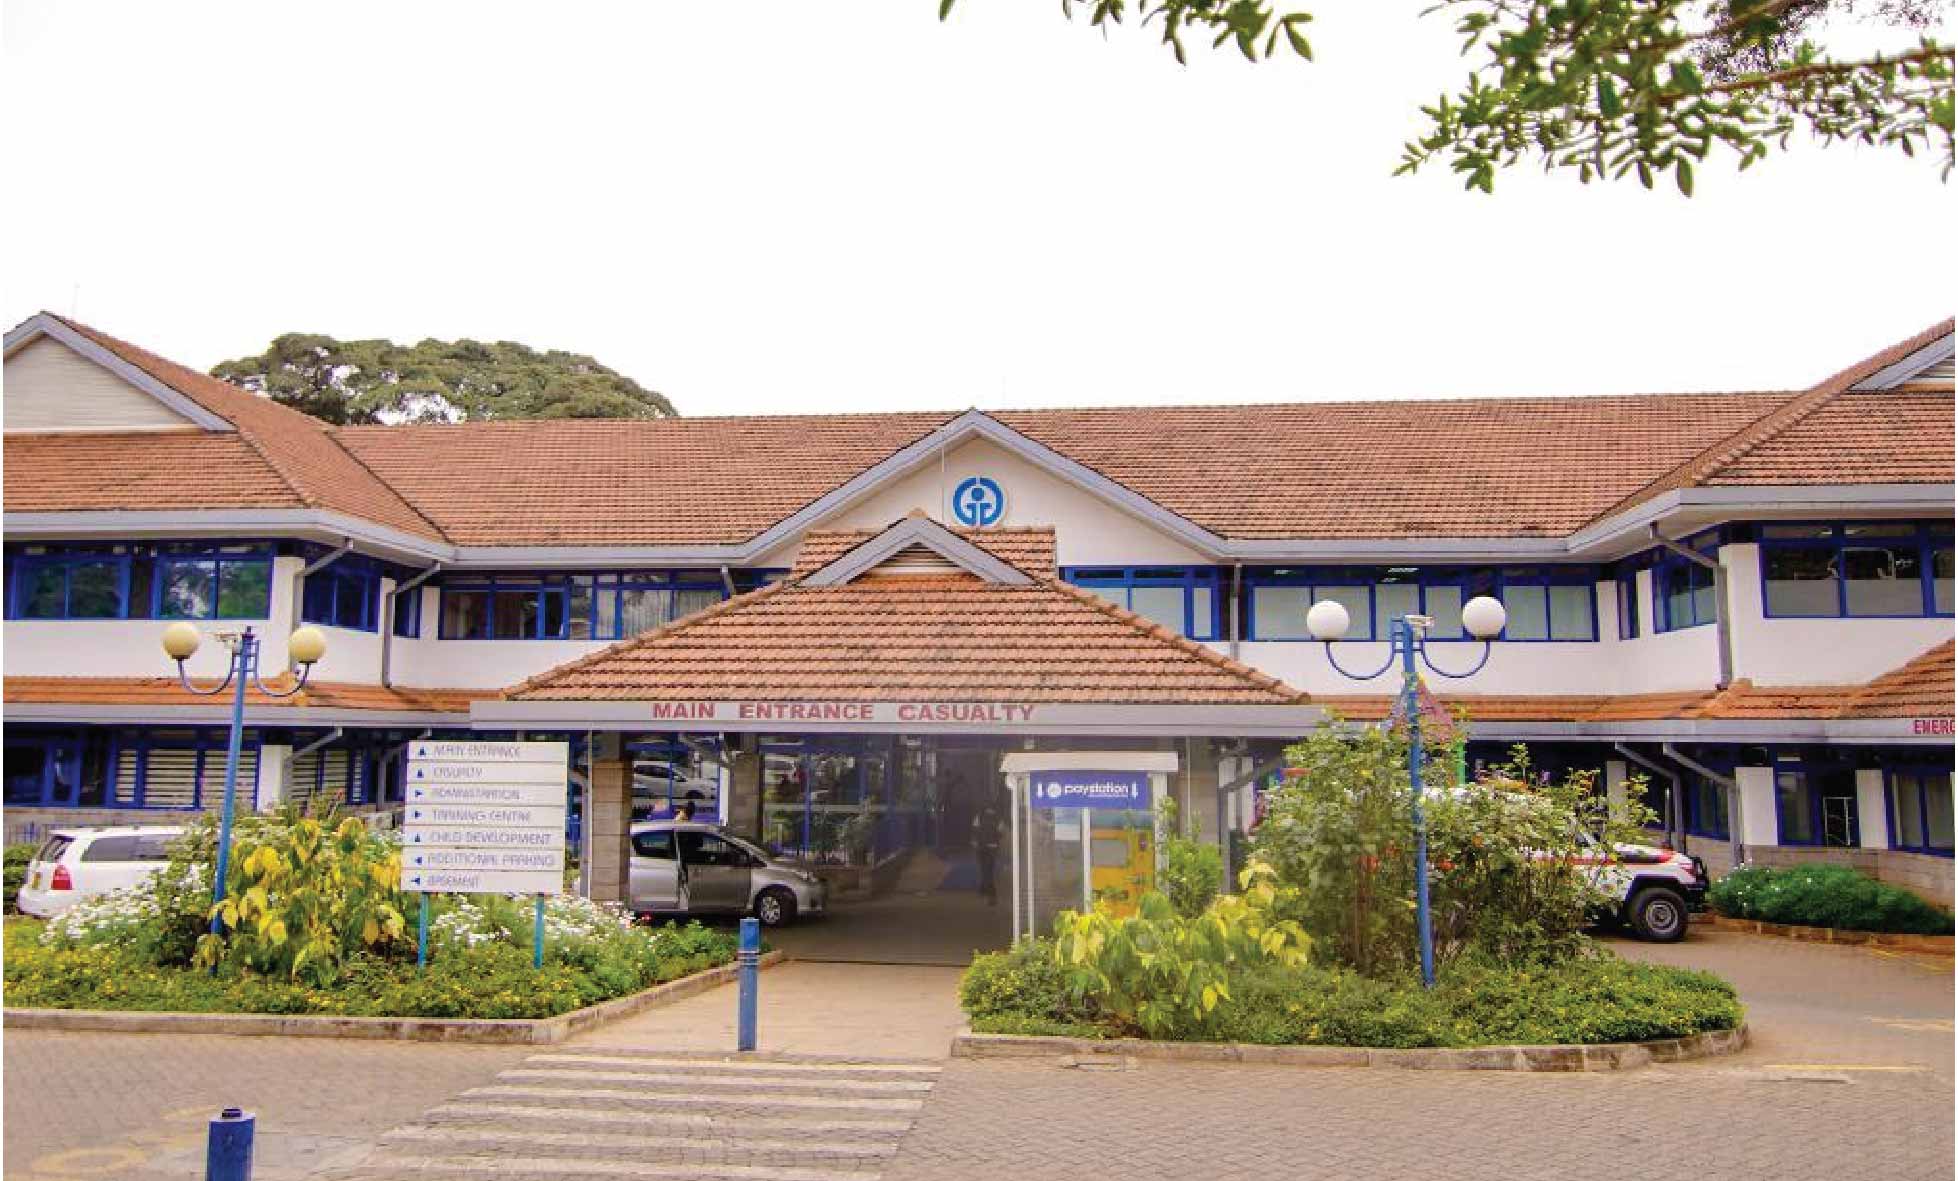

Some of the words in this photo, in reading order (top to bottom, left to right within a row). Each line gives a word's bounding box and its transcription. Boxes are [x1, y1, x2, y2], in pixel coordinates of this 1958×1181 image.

[652, 702, 715, 718] MAIN
[739, 703, 873, 720] ENTRANCE
[898, 703, 1034, 721] CASUALTY
[434, 744, 464, 757] MAIN
[468, 745, 521, 759] ENTRANCE
[433, 766, 483, 778] CASUALTY
[432, 787, 520, 800] ADMINISTRATION
[1064, 781, 1129, 795] paystation
[433, 809, 486, 822] TRAINING
[430, 831, 462, 843] CHILD
[466, 831, 552, 845] DEVELOPMENT
[427, 853, 497, 866] ADDITIONAL
[502, 854, 556, 867] PARKING
[427, 874, 479, 888] BASEMENT
